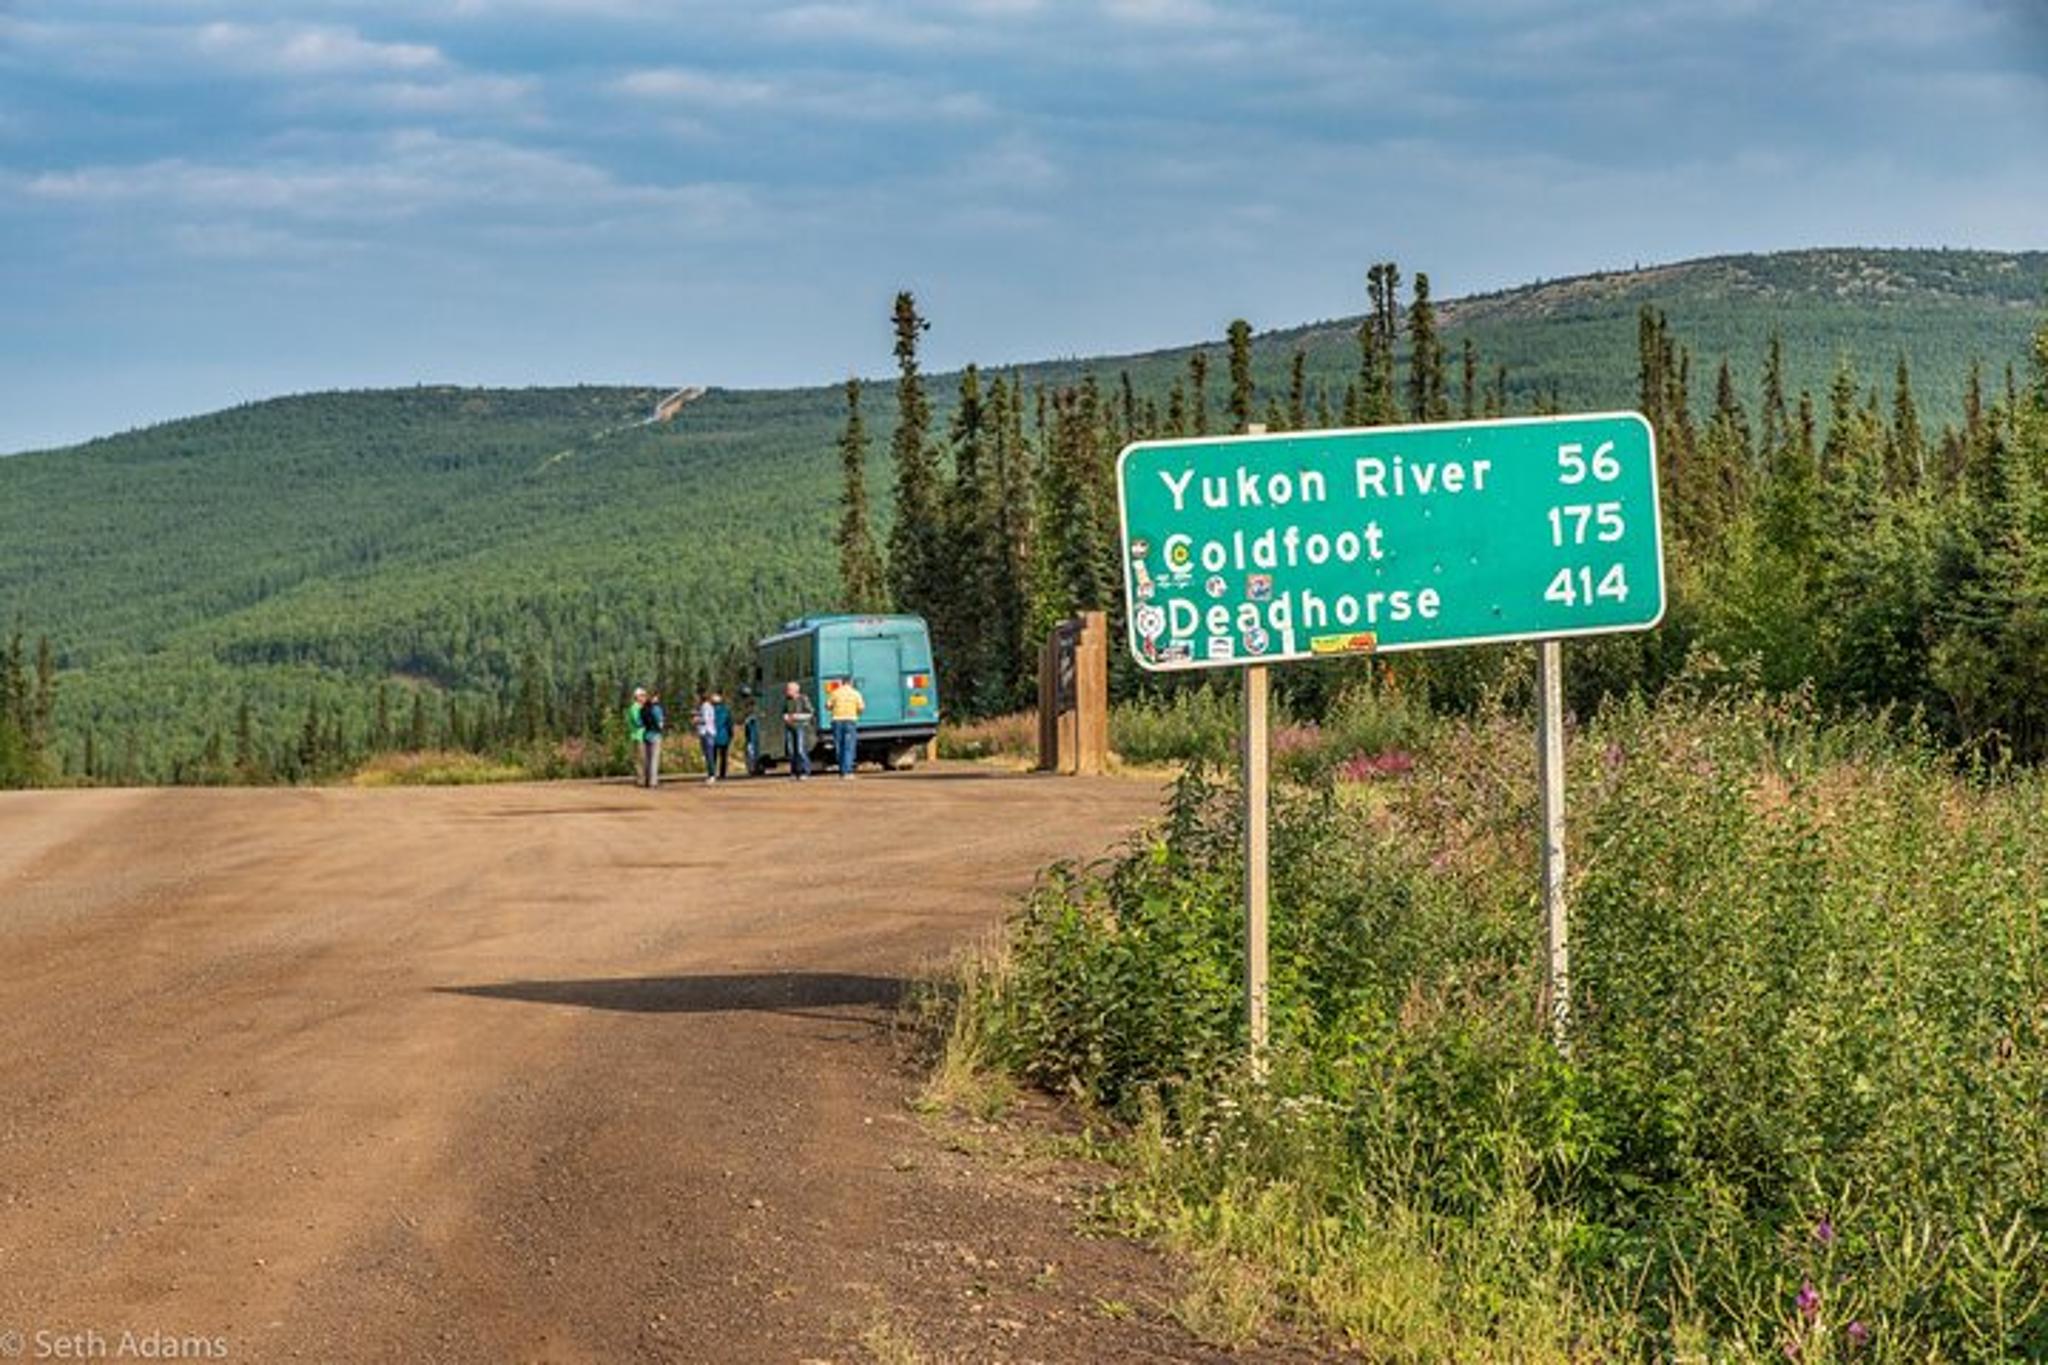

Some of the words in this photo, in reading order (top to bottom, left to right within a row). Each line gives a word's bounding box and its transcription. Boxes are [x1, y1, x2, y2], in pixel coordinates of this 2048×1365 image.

[1159, 466, 1326, 511] Yukon
[1355, 455, 1492, 499] River
[1557, 440, 1621, 485] 56
[1163, 521, 1384, 574] Coldfoot
[1547, 501, 1626, 547] 175
[1168, 587, 1441, 639] Deadhorse
[1543, 563, 1629, 607] 414
